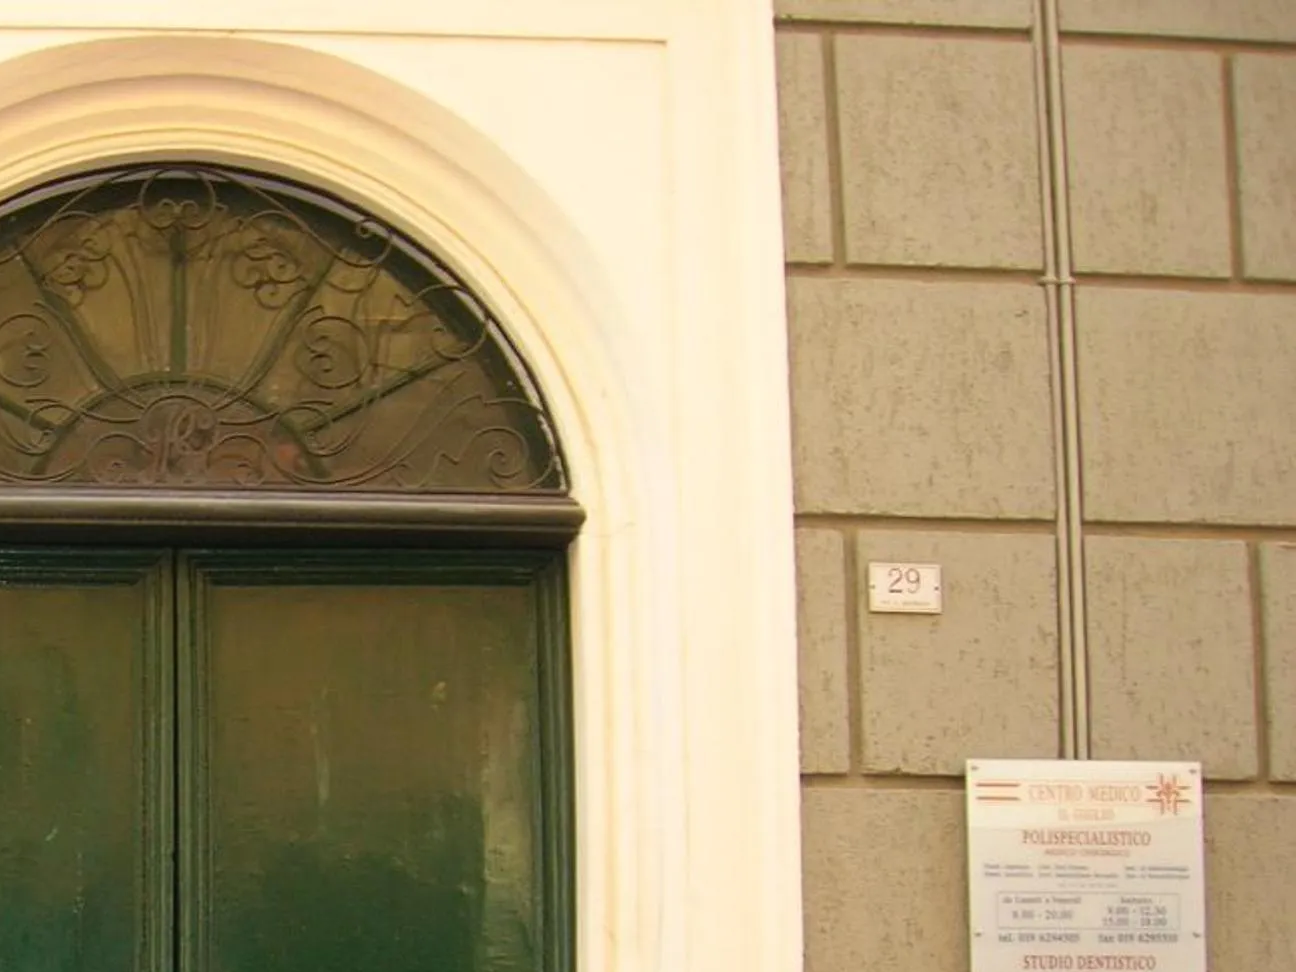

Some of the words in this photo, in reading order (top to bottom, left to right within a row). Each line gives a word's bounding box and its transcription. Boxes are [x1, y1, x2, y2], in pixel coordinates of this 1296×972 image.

[888, 567, 921, 594] 29
[1028, 784, 1083, 803] CENTRO
[1088, 785, 1142, 804] MEDICO
[1021, 829, 1152, 846] POLISPECIALISTICO
[1022, 955, 1072, 970] STUDIO
[1077, 955, 1156, 971] DENTISTICO
